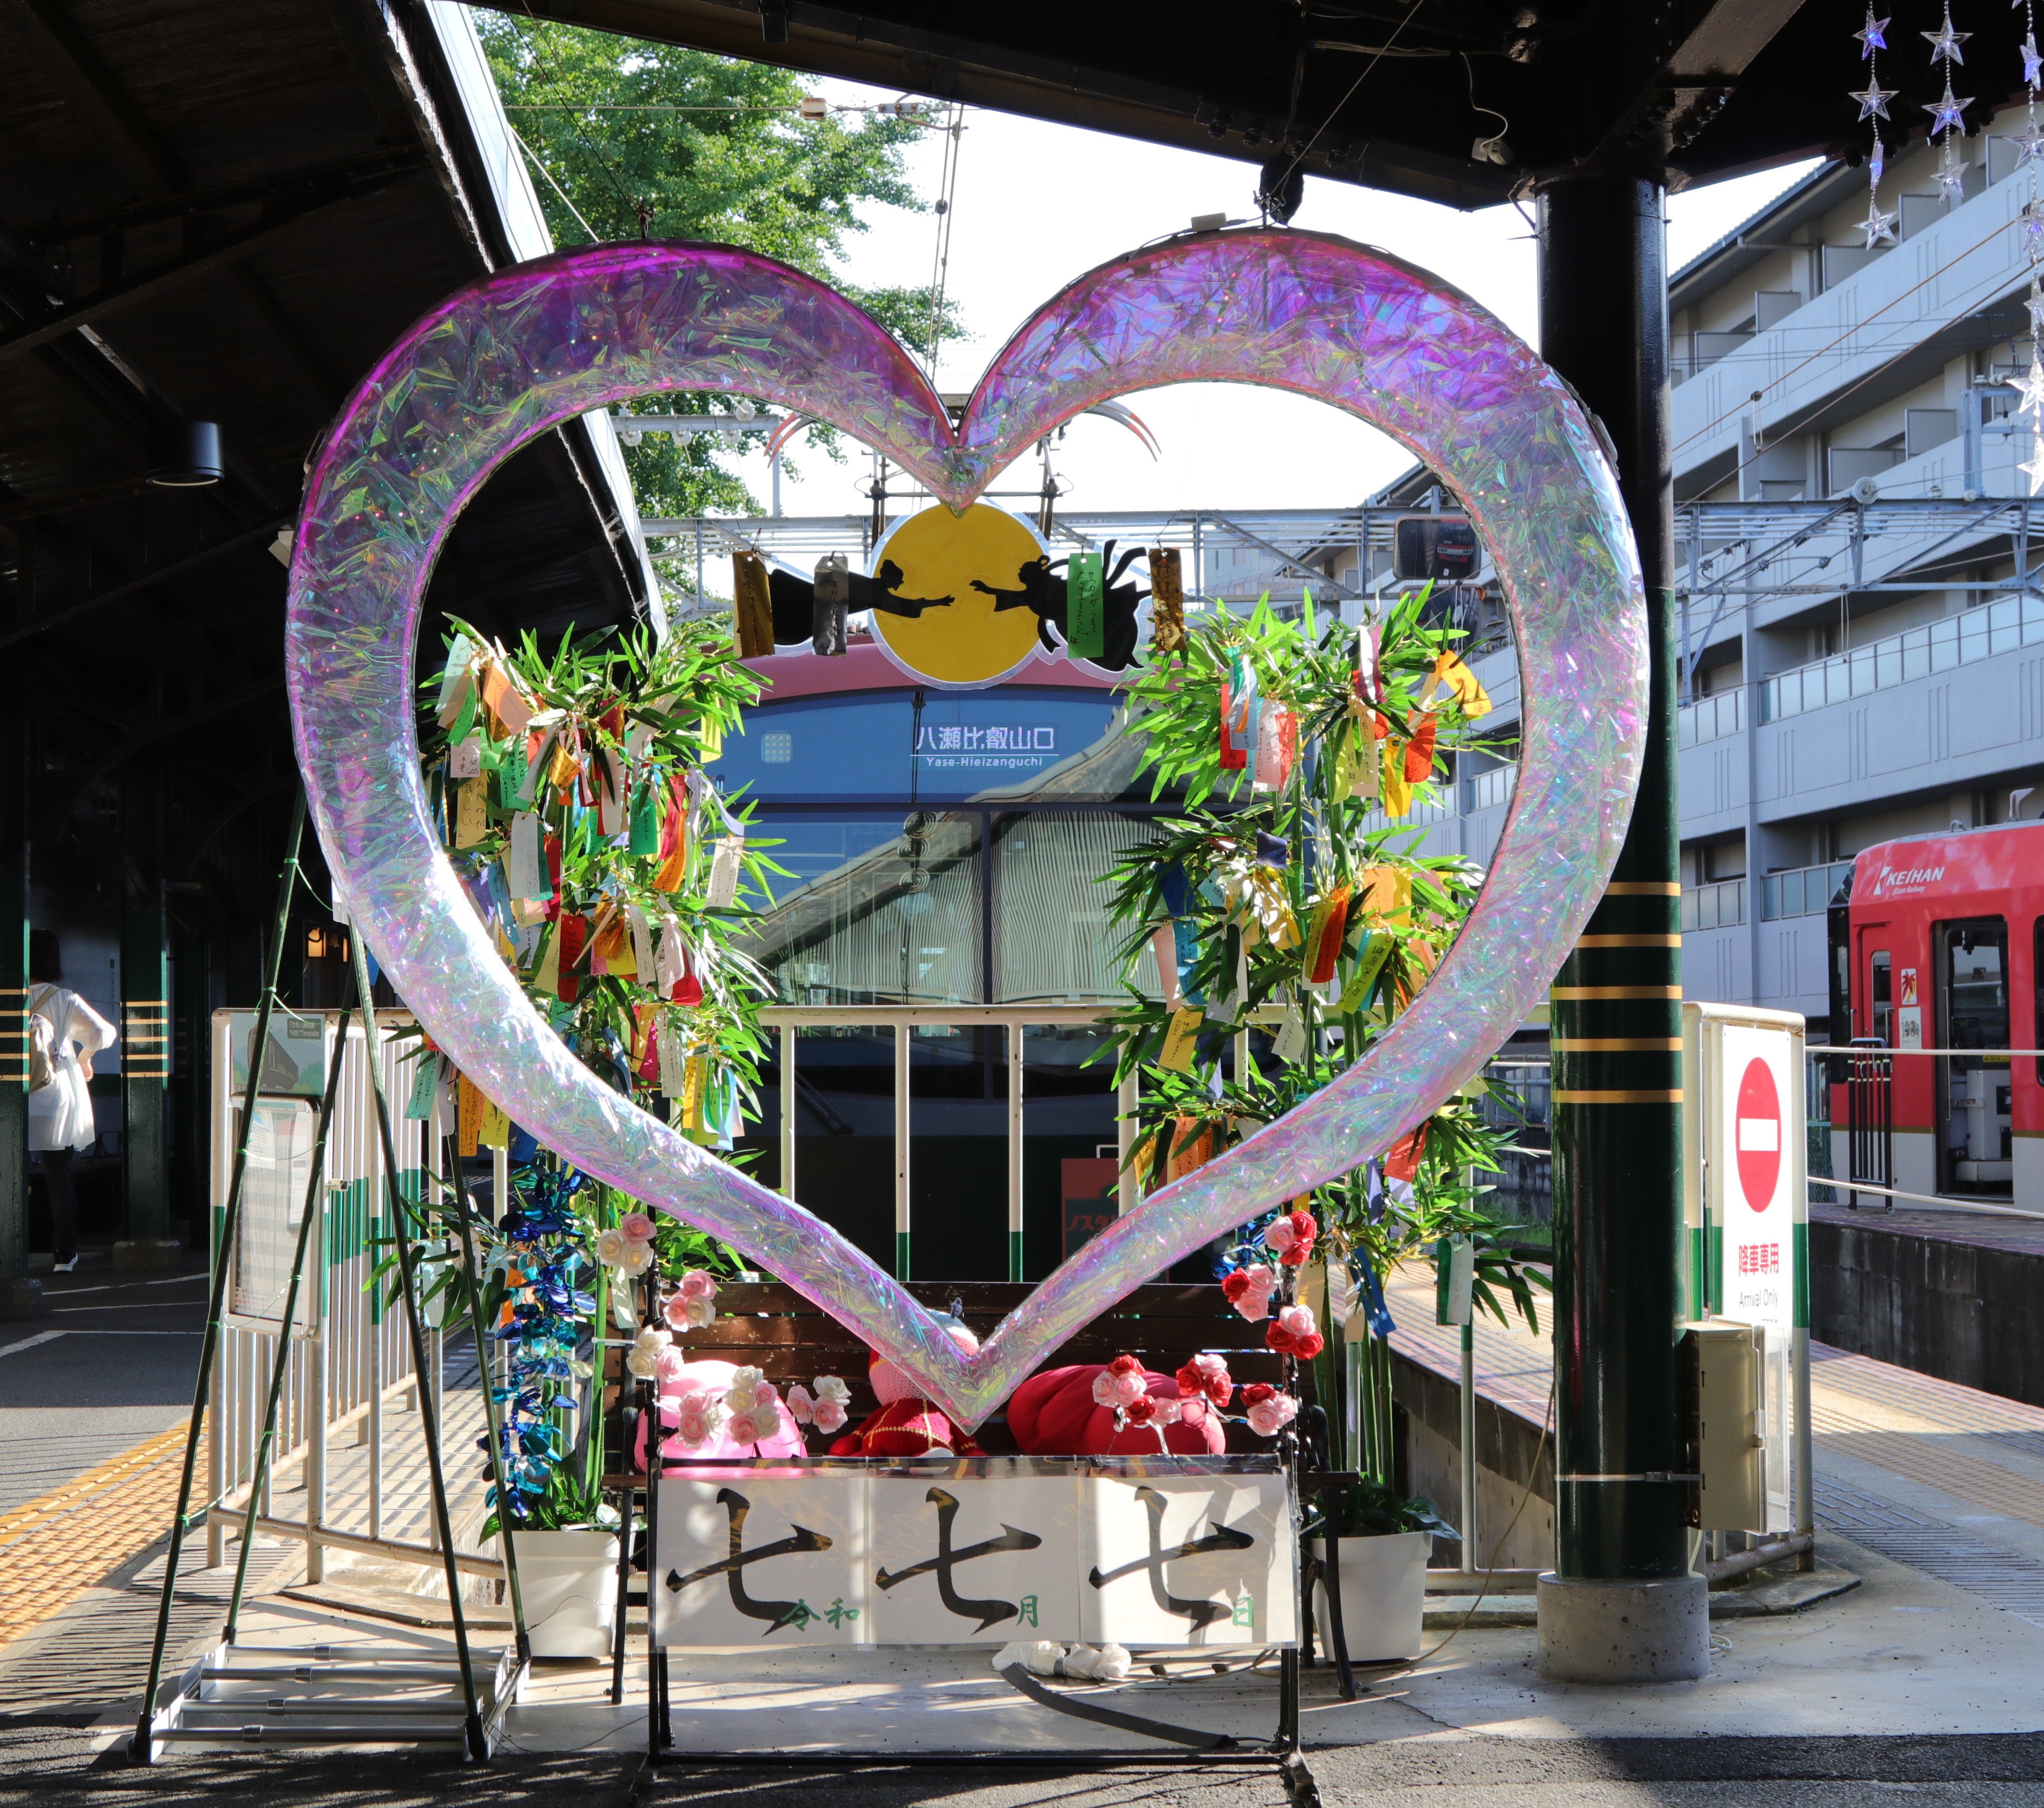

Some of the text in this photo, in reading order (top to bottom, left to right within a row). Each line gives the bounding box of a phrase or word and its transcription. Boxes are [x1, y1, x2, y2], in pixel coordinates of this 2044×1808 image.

[916, 726, 1054, 750] 八瀬比叡山口
[926, 757, 1043, 768] Yase-Hieizanguchi
[462, 784, 472, 826] ほしい
[1886, 866, 1945, 886] KEIHAN
[1906, 885, 1926, 894] Railway
[1067, 1215, 1119, 1232] ノスタ
[1739, 1243, 1779, 1277] 降車専用
[1739, 1288, 1779, 1309] Arrival Only
[780, 1594, 1255, 1633] 令和 月 日
